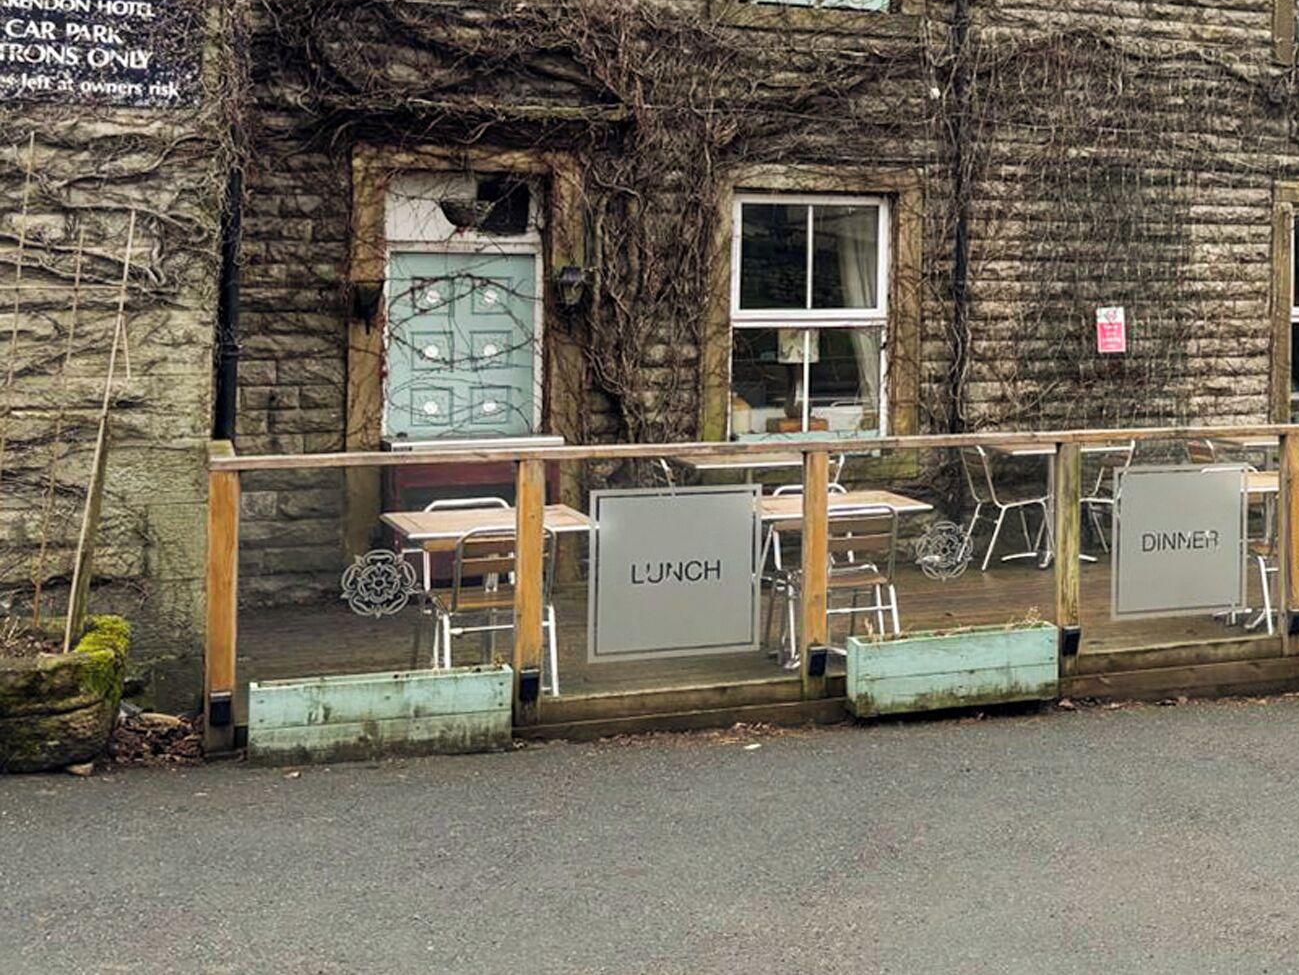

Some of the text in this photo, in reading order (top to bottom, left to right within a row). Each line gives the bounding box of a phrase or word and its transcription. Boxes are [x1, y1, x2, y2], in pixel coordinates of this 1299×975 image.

[97, 0, 156, 17] HOTEL
[5, 19, 123, 44] CAR PARK
[87, 47, 153, 70] ONLY
[22, 72, 50, 92] left
[57, 78, 74, 92] at
[80, 81, 142, 96] owners
[148, 80, 180, 100] risk
[1142, 530, 1219, 552] DINNER
[631, 560, 721, 584] LUNCH
